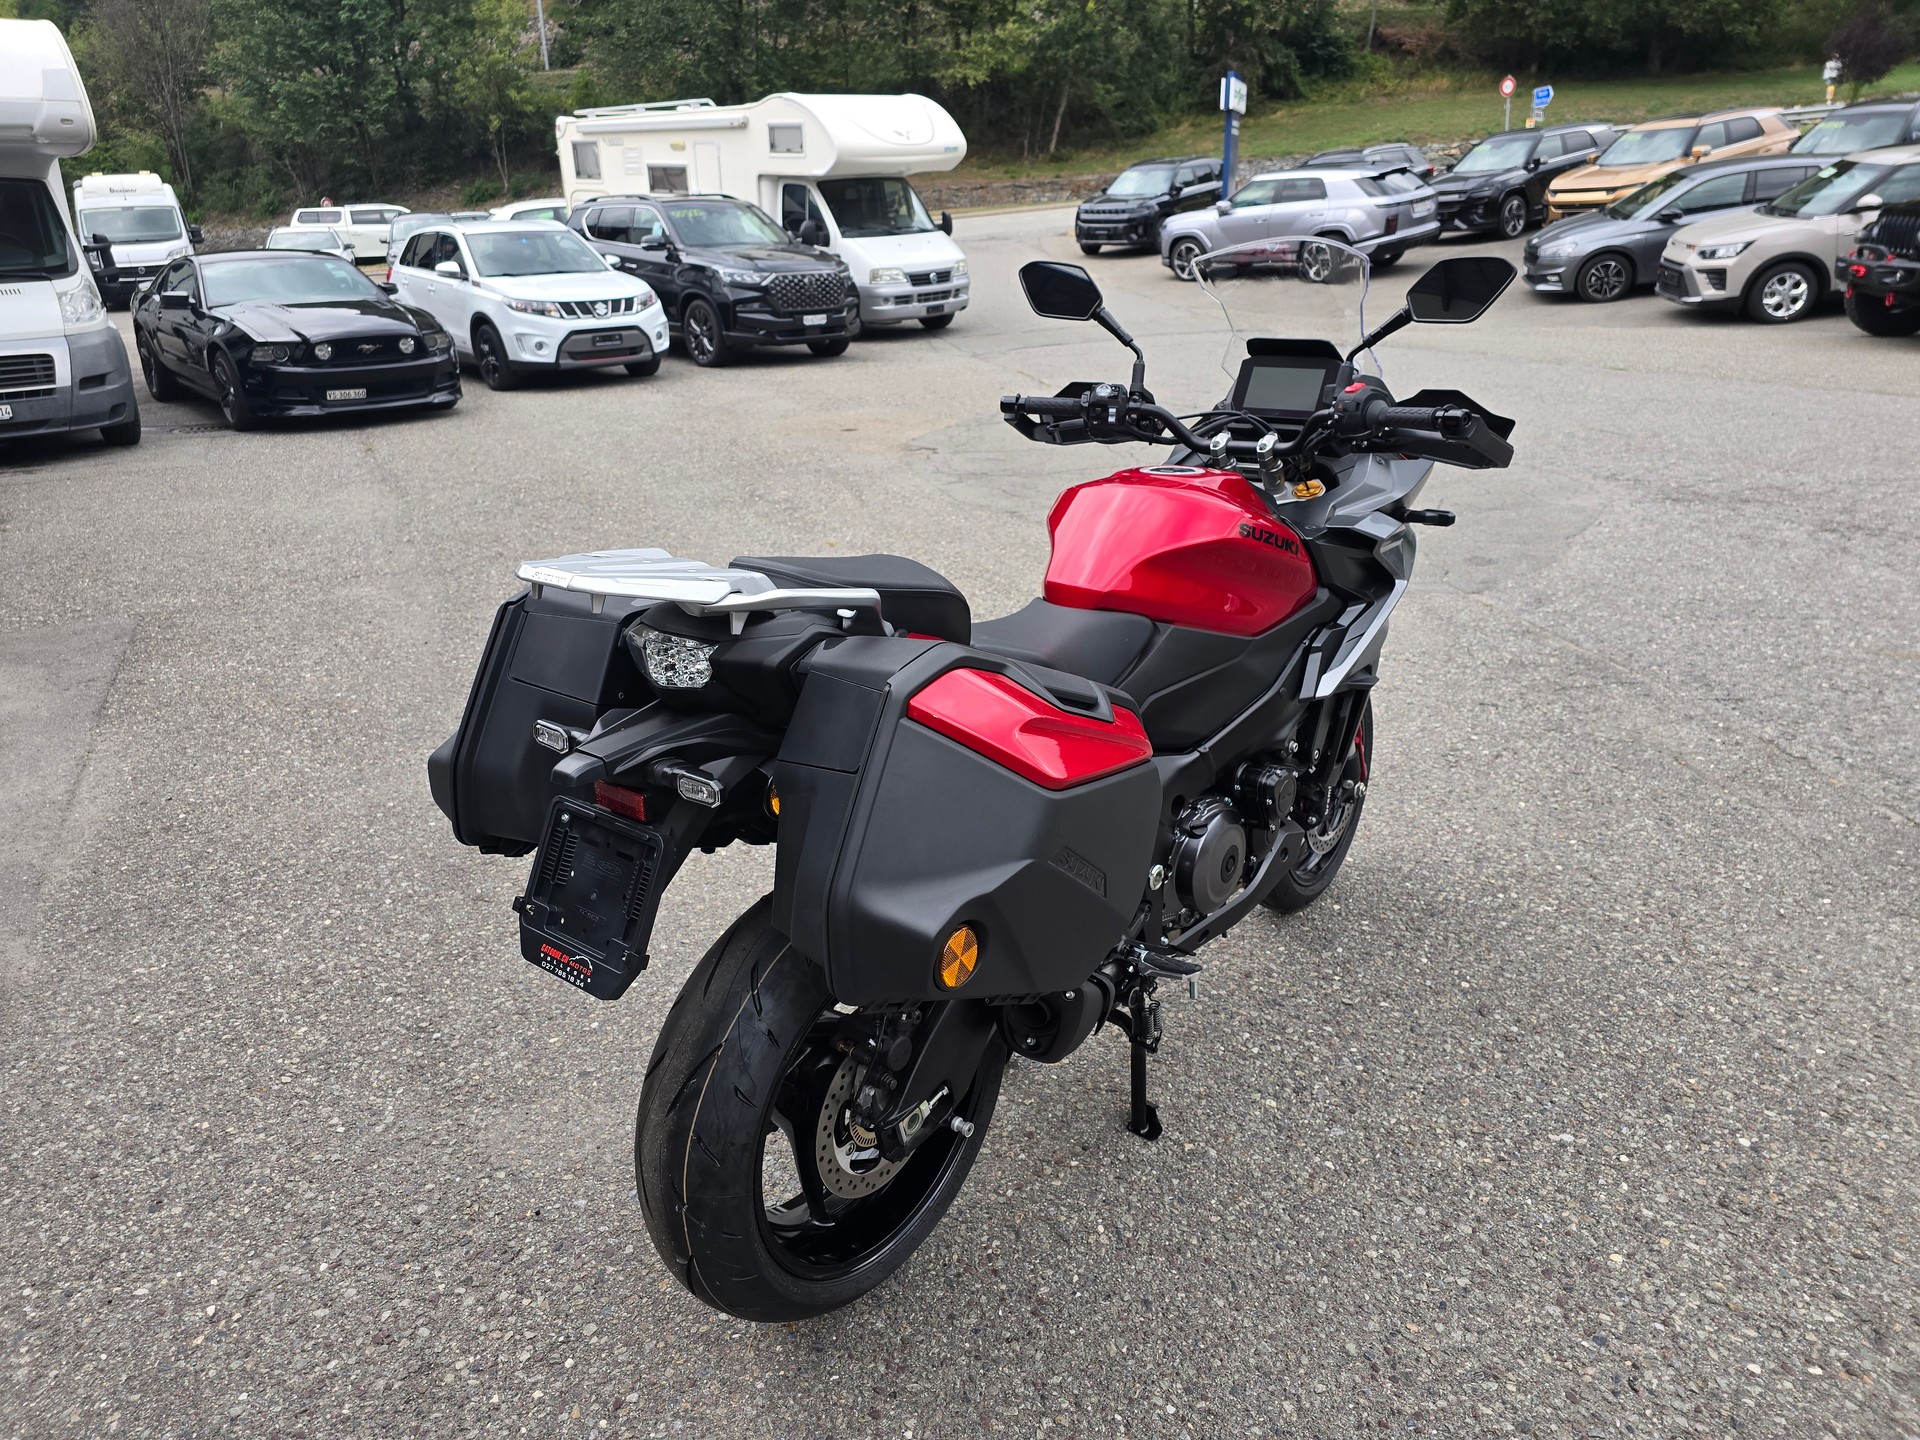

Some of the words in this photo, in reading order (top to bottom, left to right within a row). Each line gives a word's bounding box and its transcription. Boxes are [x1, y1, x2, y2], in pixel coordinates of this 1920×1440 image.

[1239, 523, 1299, 556] SUZUKI
[1056, 850, 1104, 896] SUZUKI
[541, 961, 554, 971] 027
[555, 968, 567, 978] 785
[575, 979, 585, 988] 34
[570, 961, 592, 976] MOTOS
